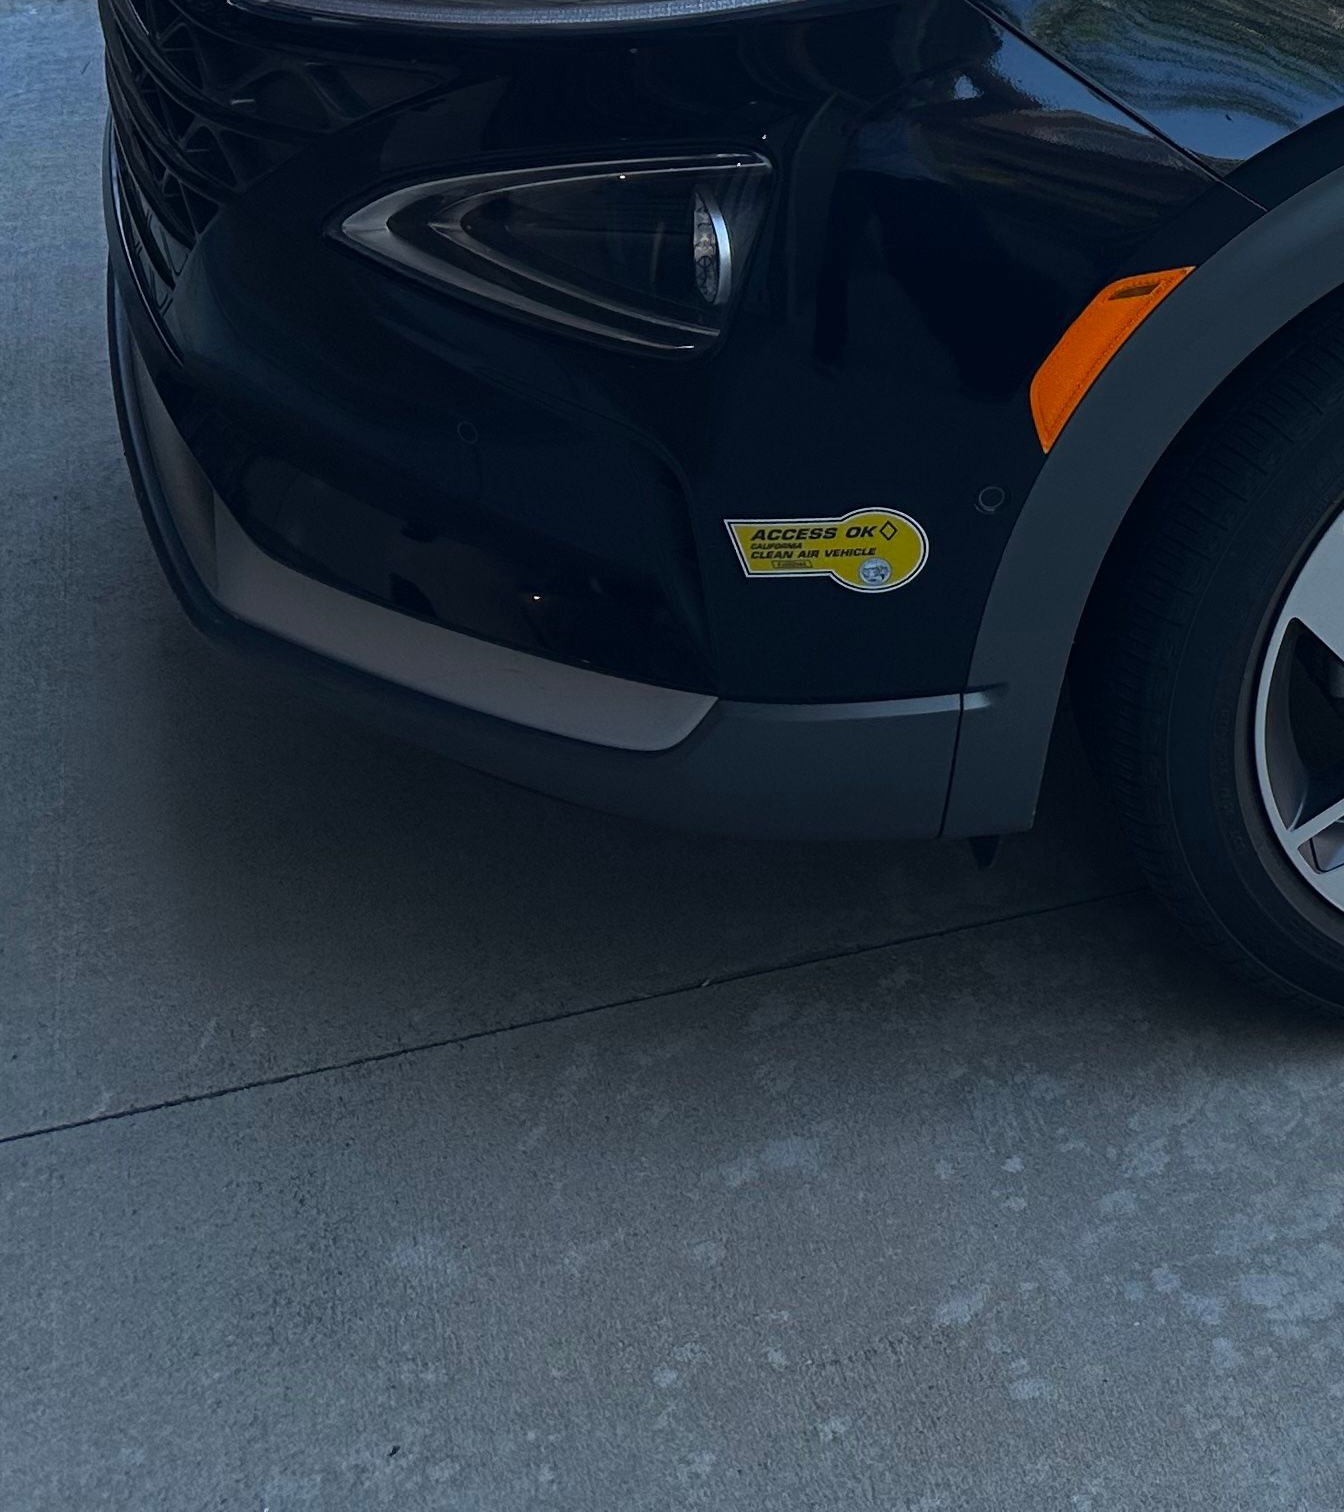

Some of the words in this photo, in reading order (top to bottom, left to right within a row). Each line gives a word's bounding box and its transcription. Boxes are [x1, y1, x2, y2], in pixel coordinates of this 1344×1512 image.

[751, 526, 837, 542] ACCESS
[845, 525, 877, 539] OK
[750, 551, 794, 560] CLEAN
[797, 550, 820, 559] AIR
[824, 547, 877, 558] VEHICLE
